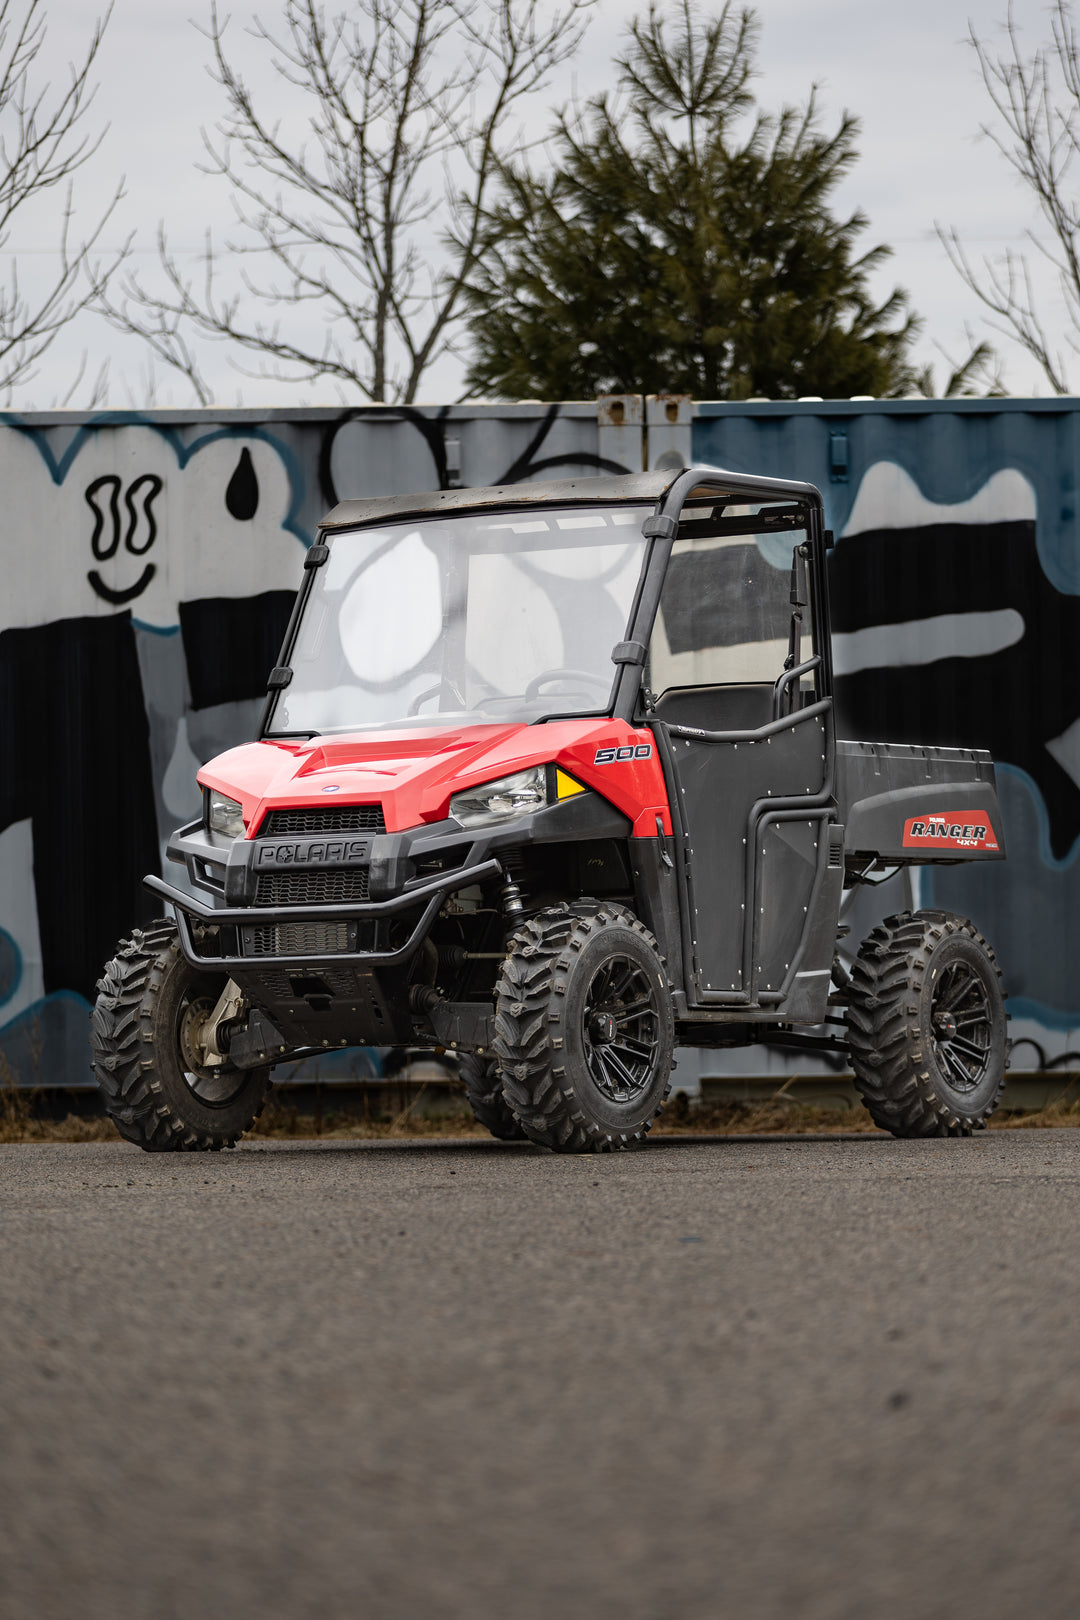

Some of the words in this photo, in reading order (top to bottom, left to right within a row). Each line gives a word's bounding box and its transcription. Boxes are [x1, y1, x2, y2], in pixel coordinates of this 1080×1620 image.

[593, 744, 652, 766] 500
[910, 822, 987, 840] RANGER
[257, 841, 369, 865] POLARIS
